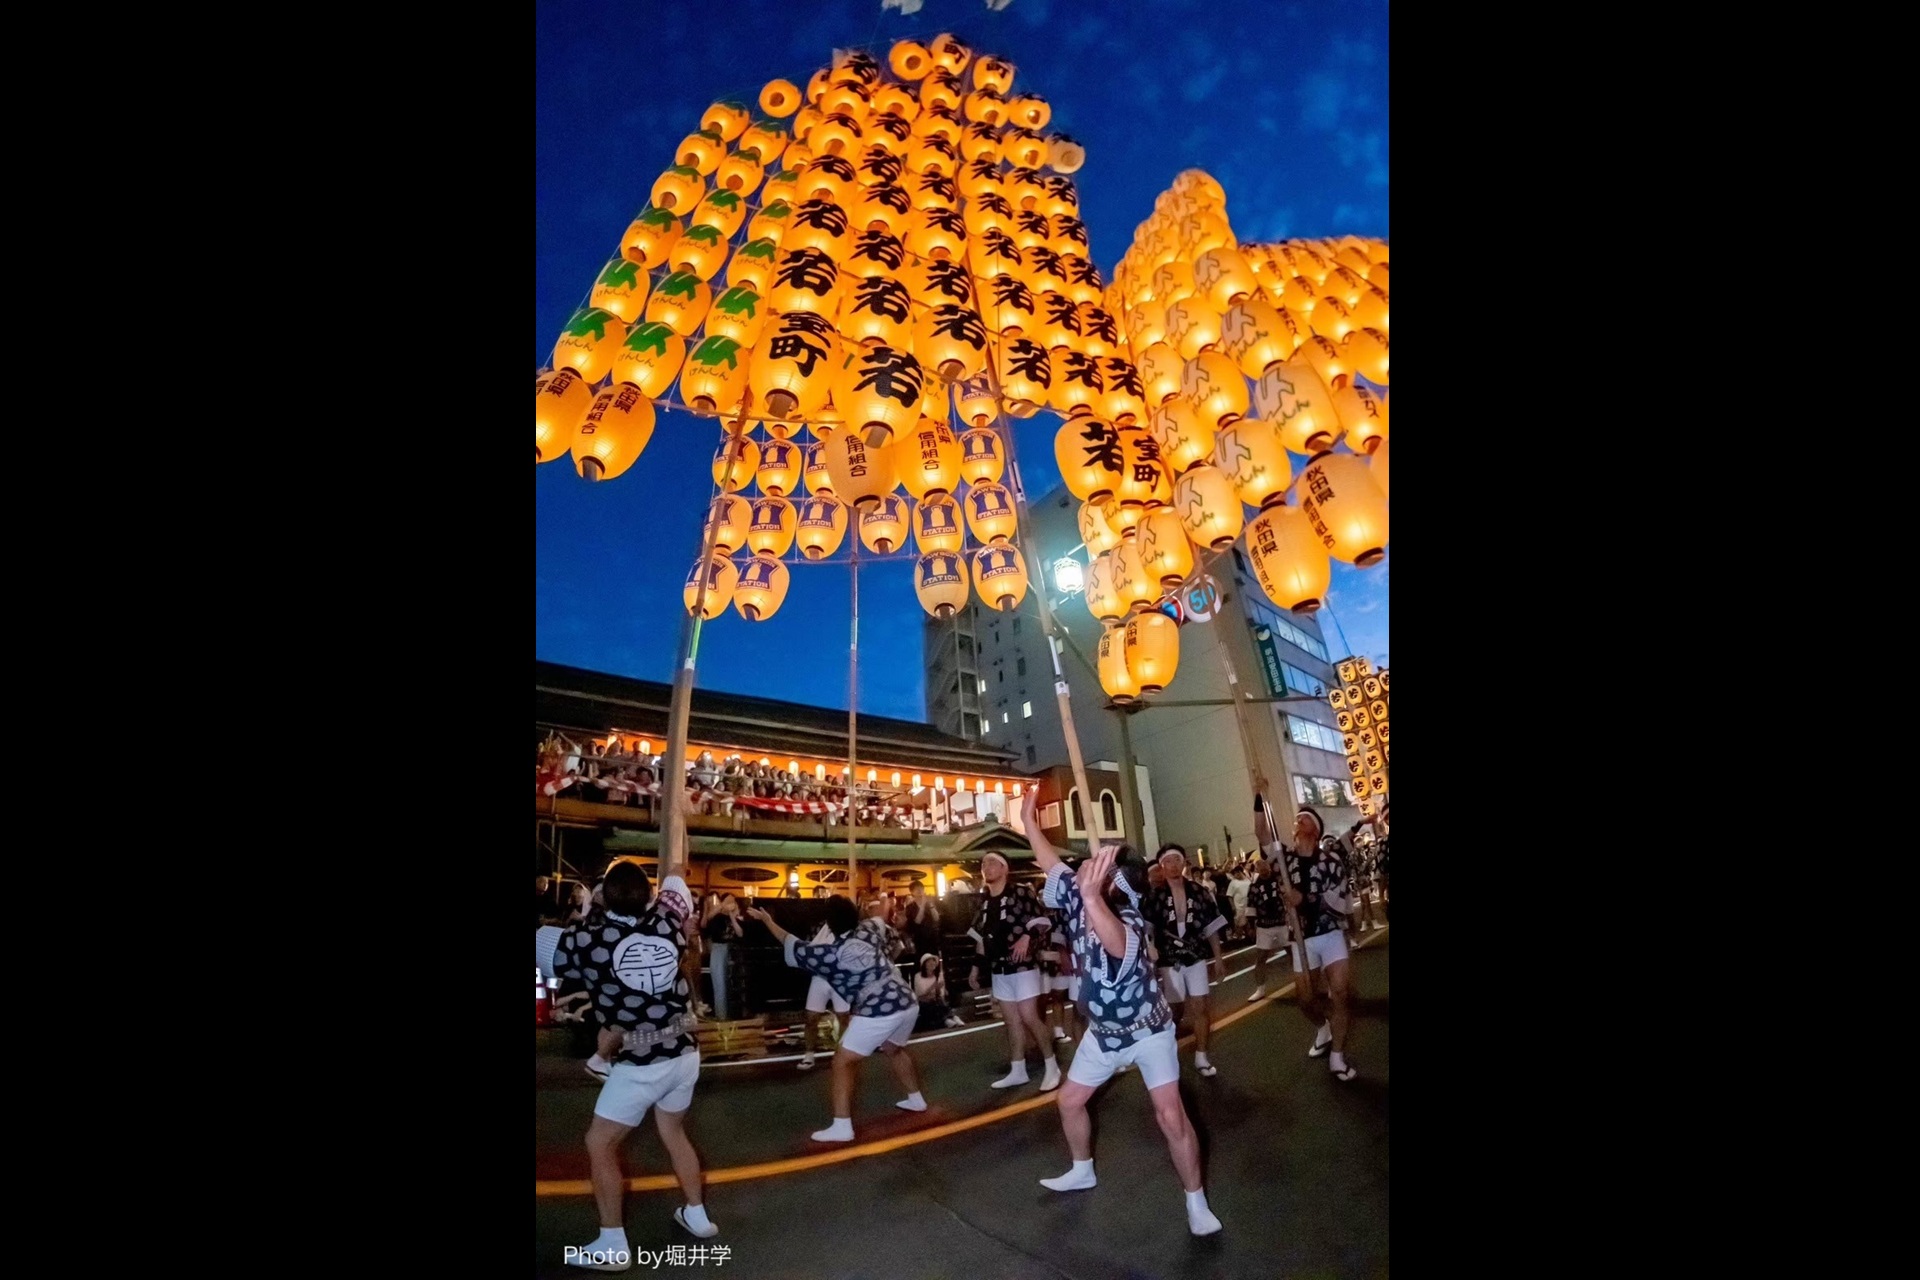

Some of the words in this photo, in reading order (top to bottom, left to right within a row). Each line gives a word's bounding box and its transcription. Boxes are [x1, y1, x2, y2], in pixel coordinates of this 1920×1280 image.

[772, 249, 838, 297] 若
[849, 230, 905, 271] 若
[849, 276, 912, 324] 若
[923, 259, 971, 305] 若
[991, 276, 1035, 315] 若
[929, 304, 988, 351] 若
[852, 346, 924, 408] 若
[1006, 338, 1052, 390] 若
[1306, 465, 1336, 506] 秋田県
[1254, 518, 1279, 558] 秋田県
[1126, 620, 1138, 647] 秋田県
